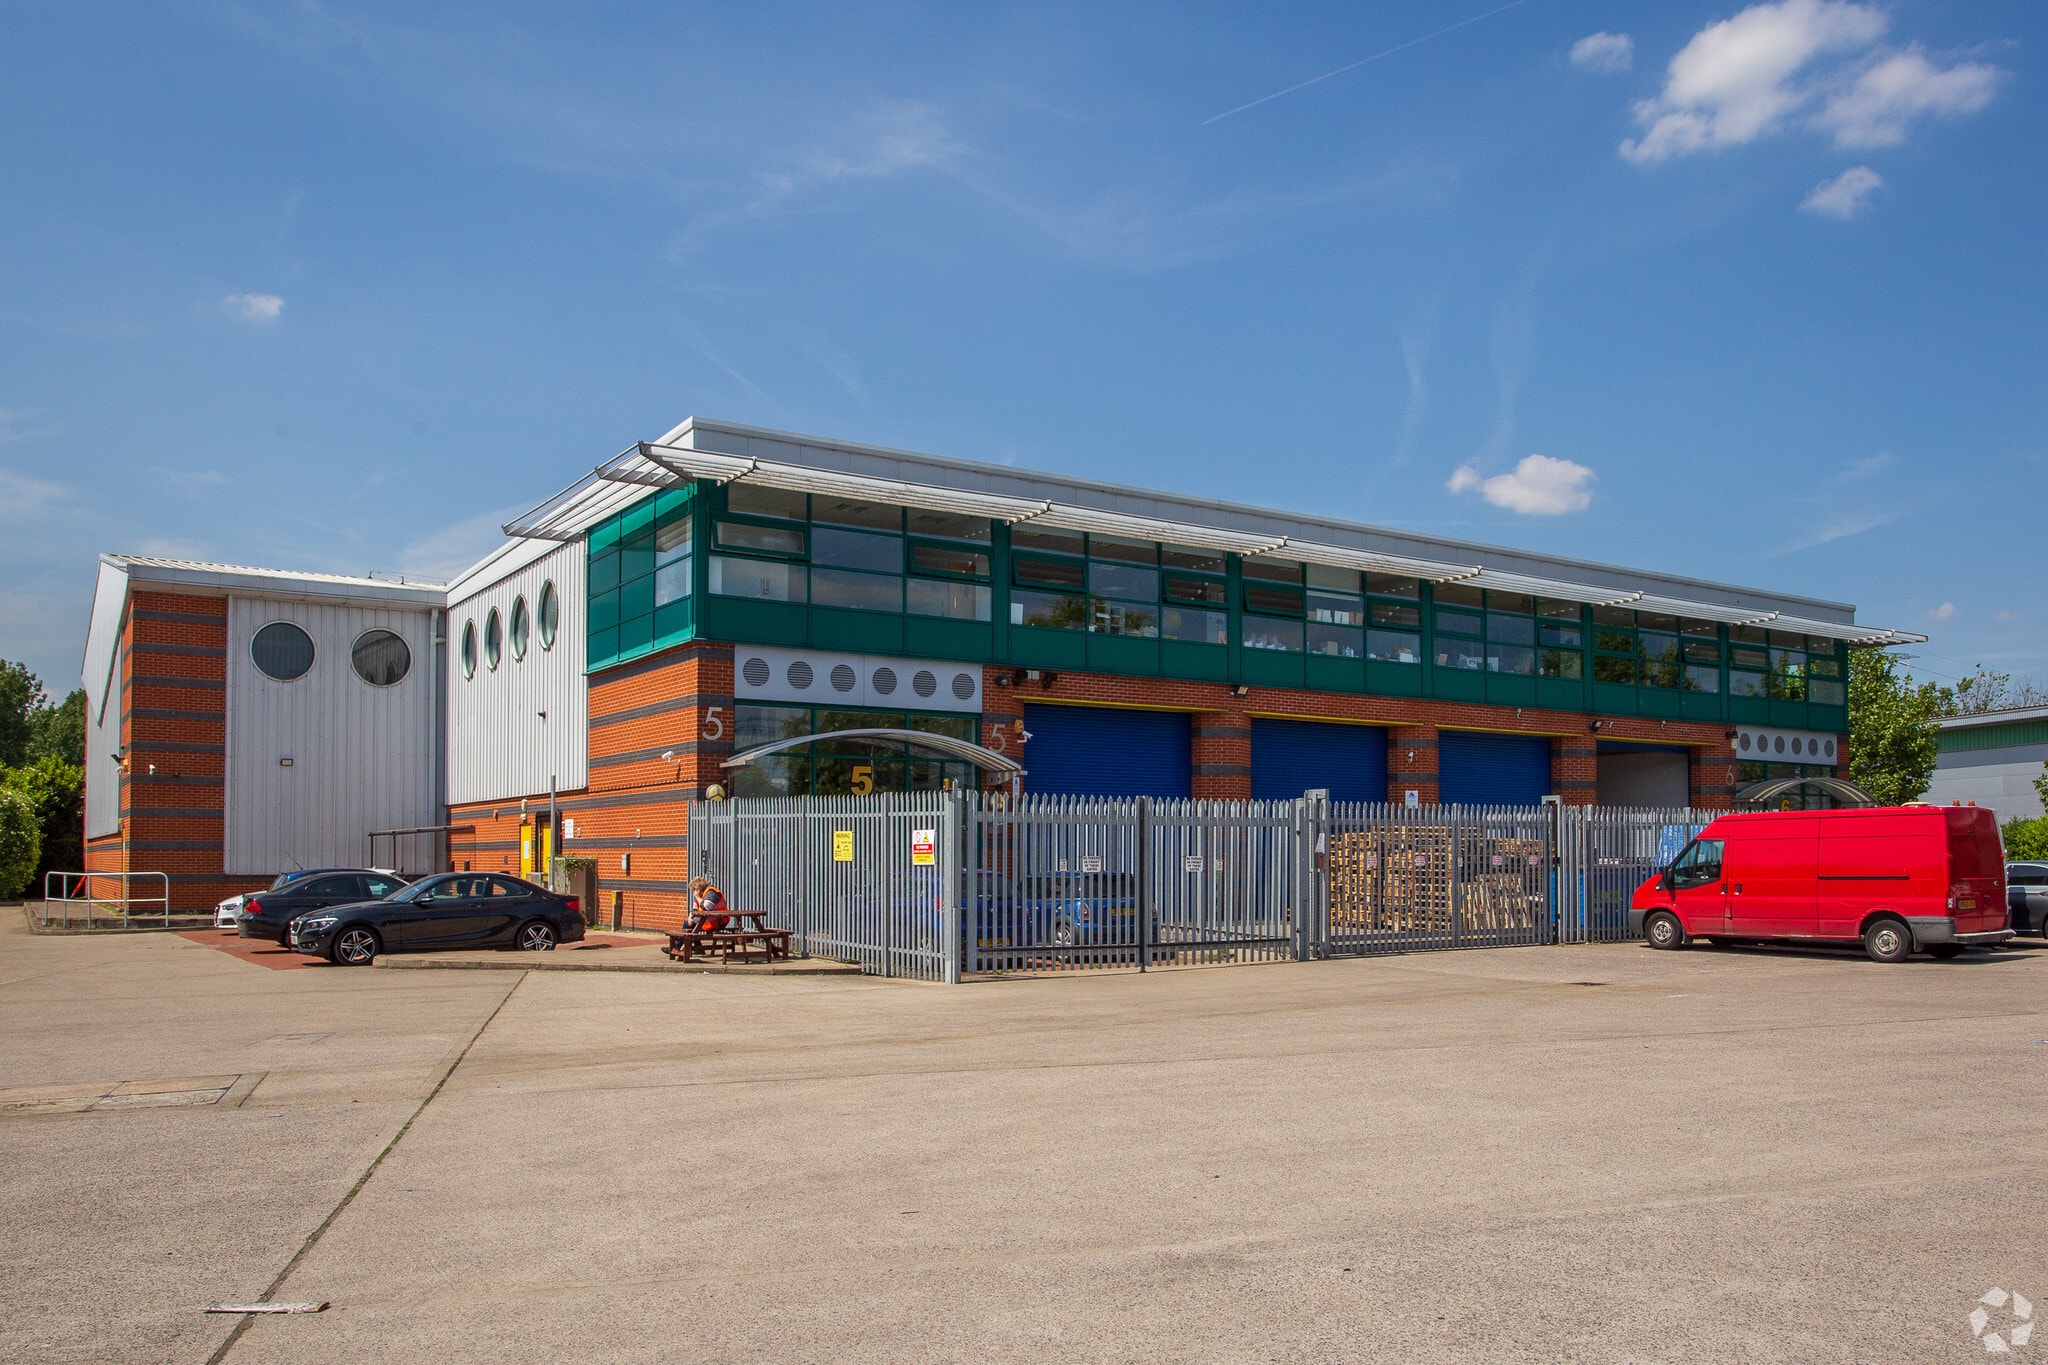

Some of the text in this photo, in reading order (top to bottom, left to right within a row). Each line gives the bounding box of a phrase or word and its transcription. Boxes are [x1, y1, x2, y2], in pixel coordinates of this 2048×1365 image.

[702, 706, 723, 741] 5
[989, 723, 1006, 754] 5
[850, 765, 873, 796] 5
[1726, 764, 1734, 786] 6
[1781, 799, 1791, 811] 6
